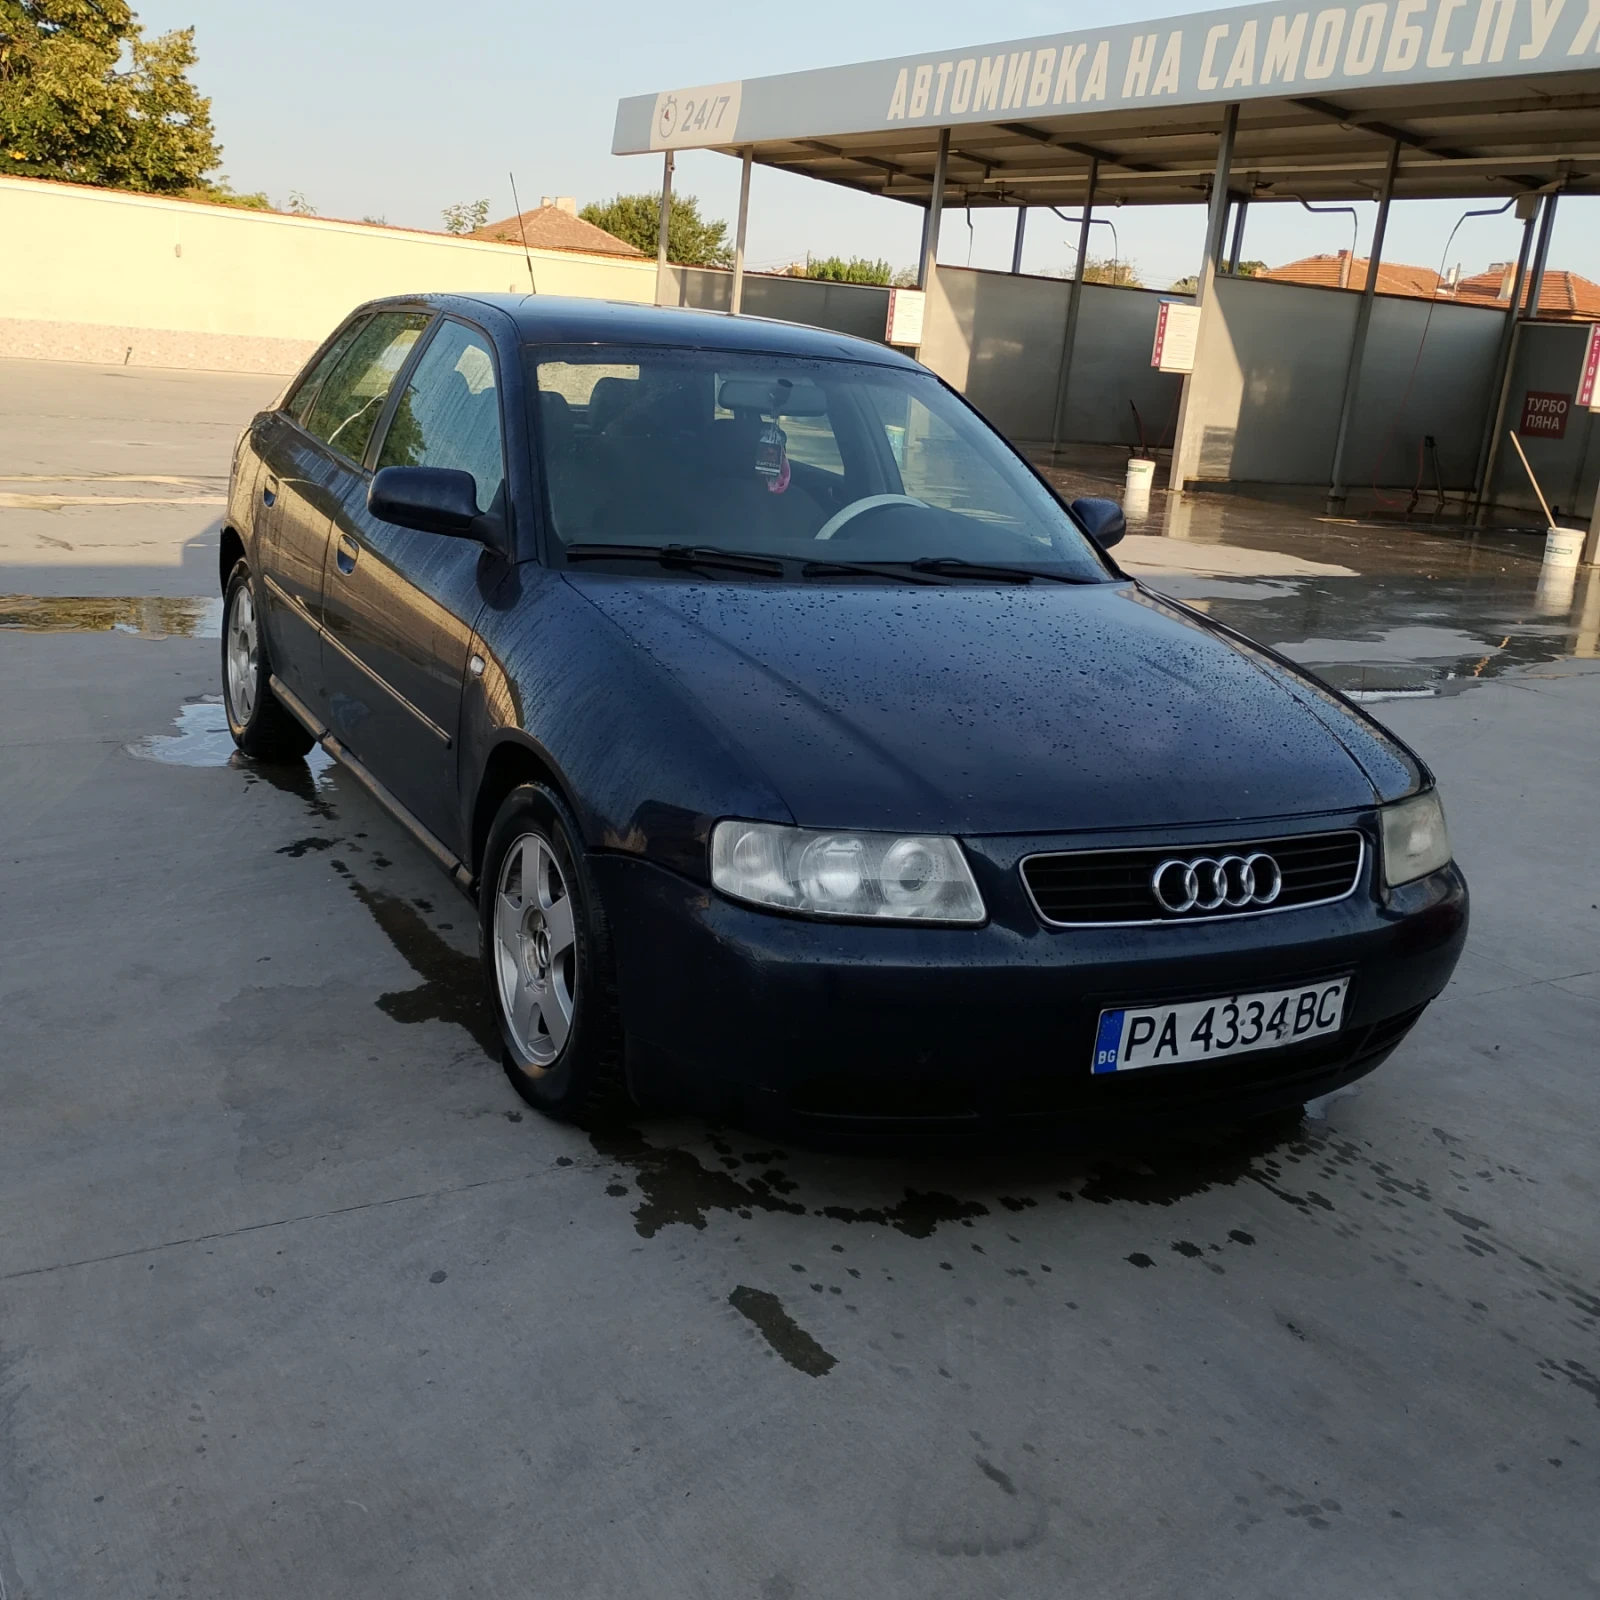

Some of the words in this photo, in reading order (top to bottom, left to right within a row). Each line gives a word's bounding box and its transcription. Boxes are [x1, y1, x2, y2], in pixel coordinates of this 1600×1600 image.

[887, 41, 1110, 120] АВТОМИВКА
[1121, 30, 1183, 98] НА
[680, 95, 731, 132] 24/7
[1527, 397, 1567, 414] ТУРБО
[1525, 414, 1560, 430] ПЯНА
[1124, 1011, 1179, 1062] PA
[1190, 996, 1290, 1053] 4334
[1294, 985, 1340, 1036] BC
[1097, 1049, 1116, 1065] BG
